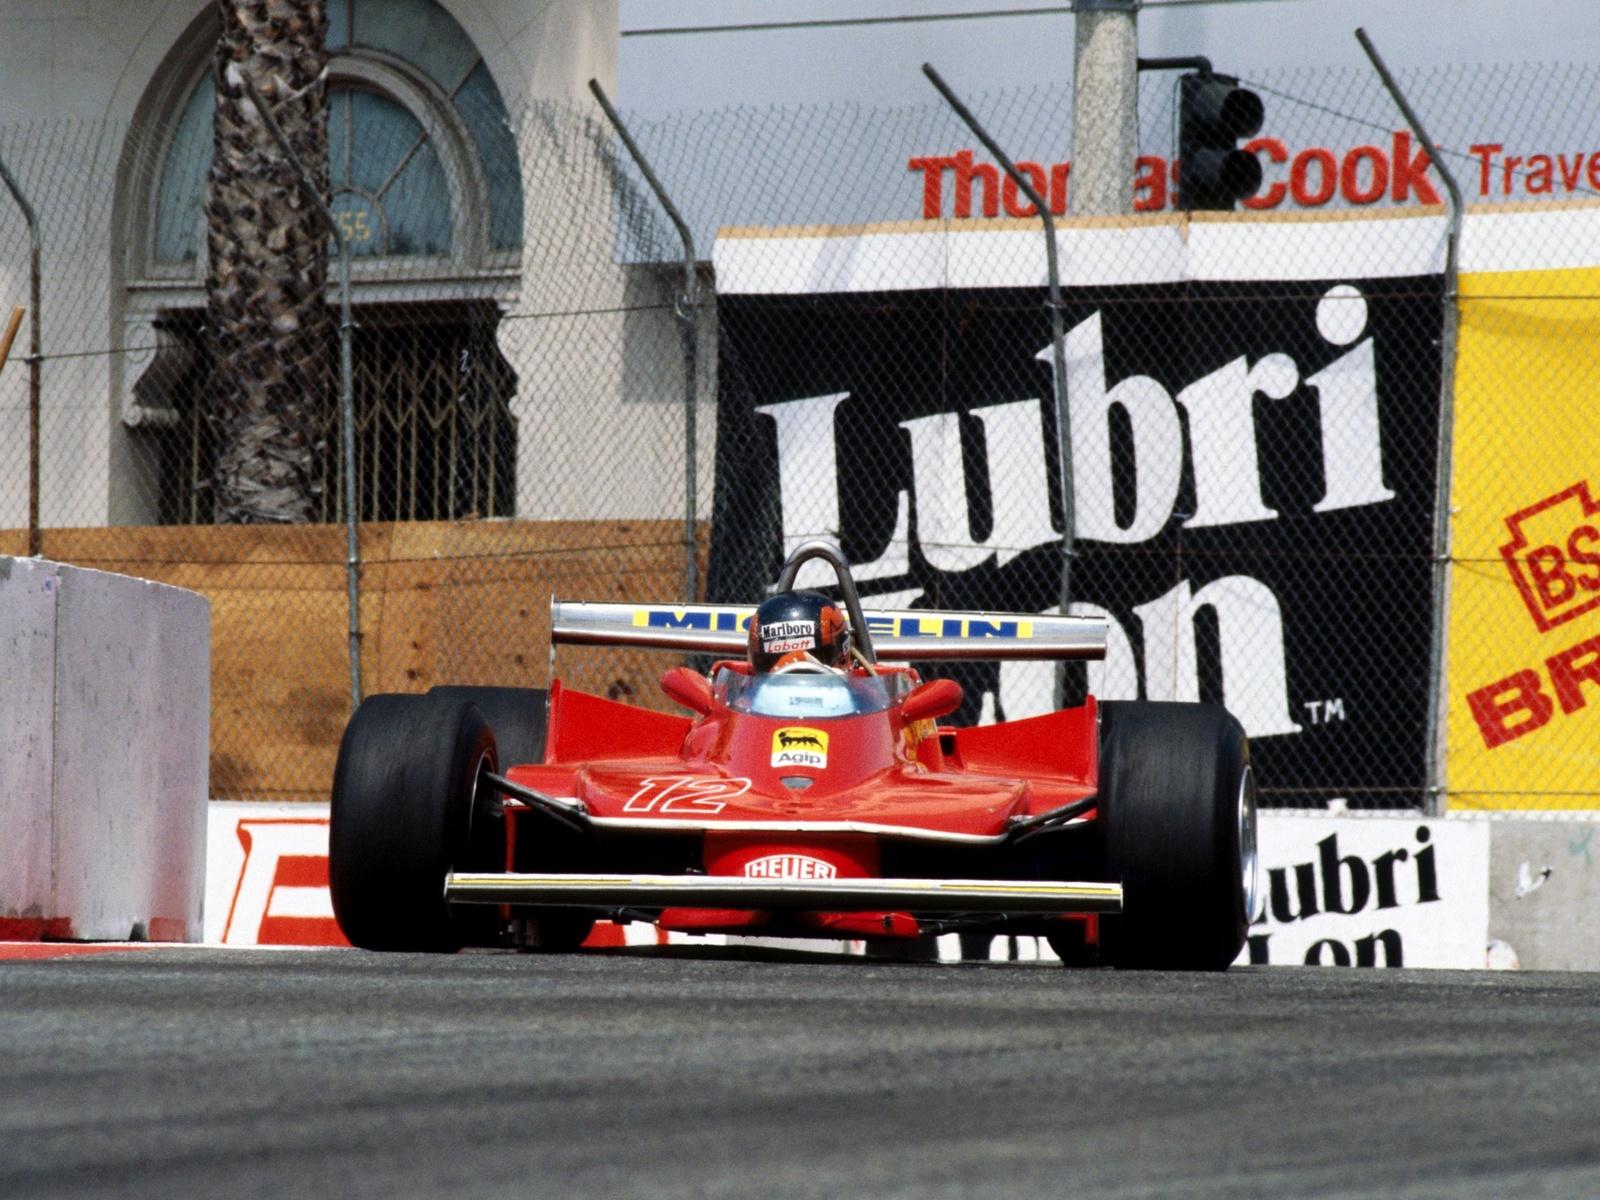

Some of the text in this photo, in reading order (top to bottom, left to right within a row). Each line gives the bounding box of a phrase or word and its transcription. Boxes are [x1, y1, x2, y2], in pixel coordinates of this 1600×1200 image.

[908, 149, 1180, 219] Thoa
[1236, 130, 1441, 210] Cook
[755, 284, 1397, 596] Lubri
[649, 611, 1018, 638] MIELIN
[762, 623, 813, 638] Marlboro
[768, 640, 811, 653] Labatt
[1303, 697, 1345, 725] TM
[778, 752, 821, 764] Agip
[623, 776, 752, 813] 12
[751, 857, 830, 880] HEUER
[1252, 825, 1442, 925] ubri
